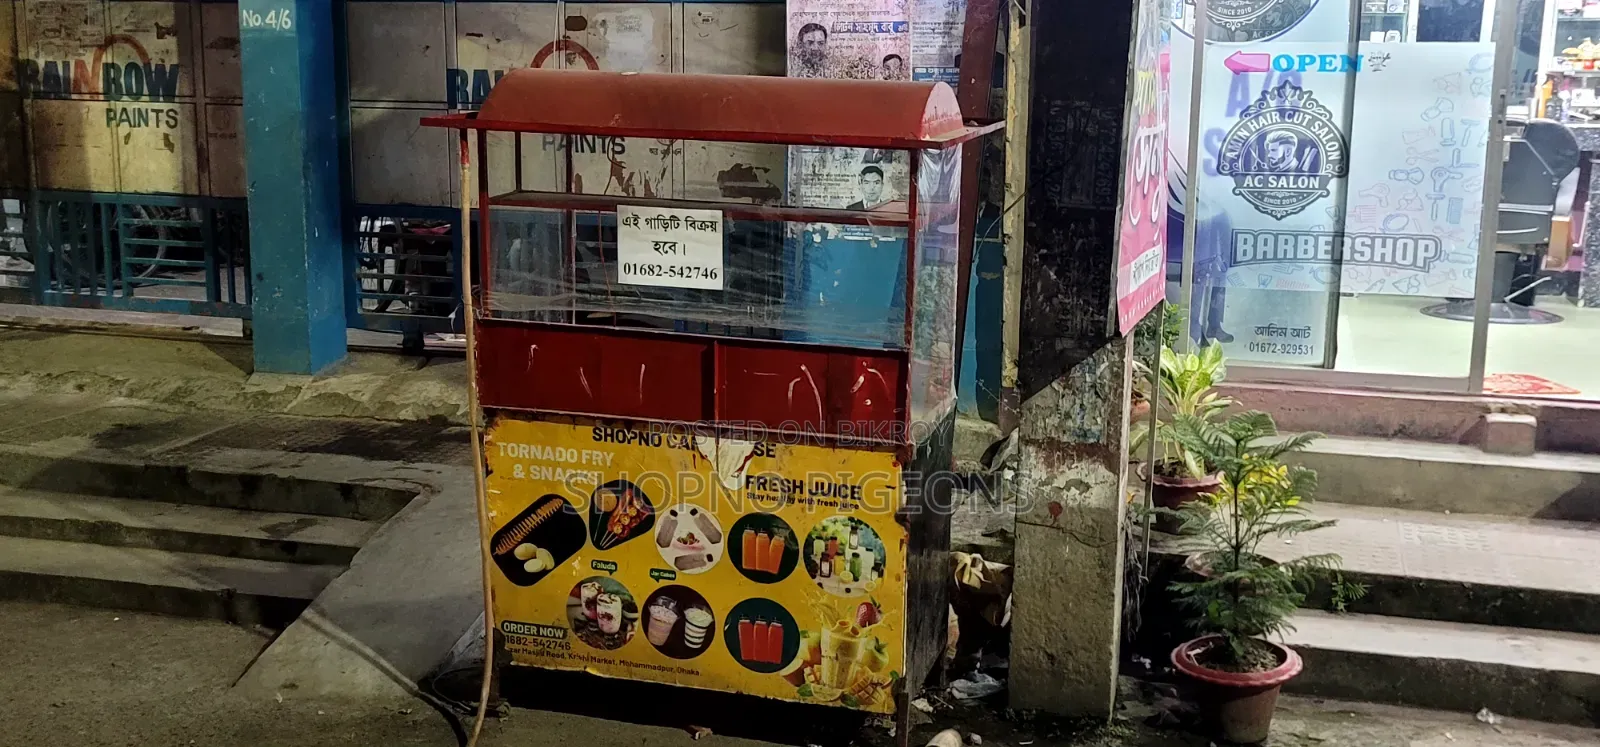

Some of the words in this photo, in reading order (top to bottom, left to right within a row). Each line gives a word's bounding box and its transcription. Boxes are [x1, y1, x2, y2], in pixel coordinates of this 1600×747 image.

[1217, 6, 1236, 16] SINCE
[1237, 6, 1252, 15] 2010
[1271, 54, 1364, 73] OPEN
[19, 58, 180, 102] RAINBOW
[105, 107, 179, 129] PAINTS
[542, 133, 626, 155] PAINTS
[1225, 127, 1251, 160] AMIN
[1247, 111, 1282, 133] HAIR
[1284, 111, 1313, 127] CUT
[1310, 120, 1342, 161] SALON
[1243, 175, 1264, 188] AC
[1267, 175, 1321, 189] SALON
[1263, 196, 1281, 205] SINCE
[622, 212, 641, 230] এই
[645, 214, 681, 232] গাড়িটি
[684, 215, 719, 233] বিক্রয়
[1233, 230, 1439, 271] BARBERSHOP
[623, 262, 718, 280] 01682-542746
[1254, 322, 1288, 338] আলিম
[1248, 341, 1314, 356] 01672-929531
[592, 426, 662, 448] SHOPNO
[496, 442, 578, 463] TORNADO
[581, 450, 615, 467] FRY
[513, 463, 525, 479] &
[529, 464, 599, 485] SNACKS
[745, 475, 804, 495] FRESH
[808, 481, 862, 500] JUICE
[746, 492, 765, 502] Stay
[797, 497, 815, 505] with
[817, 498, 838, 508] fresh
[839, 501, 860, 510] juice
[592, 561, 616, 571] Faluda
[503, 622, 538, 635] ORDER
[539, 627, 565, 639] NOW
[505, 635, 572, 651] 1682-542746
